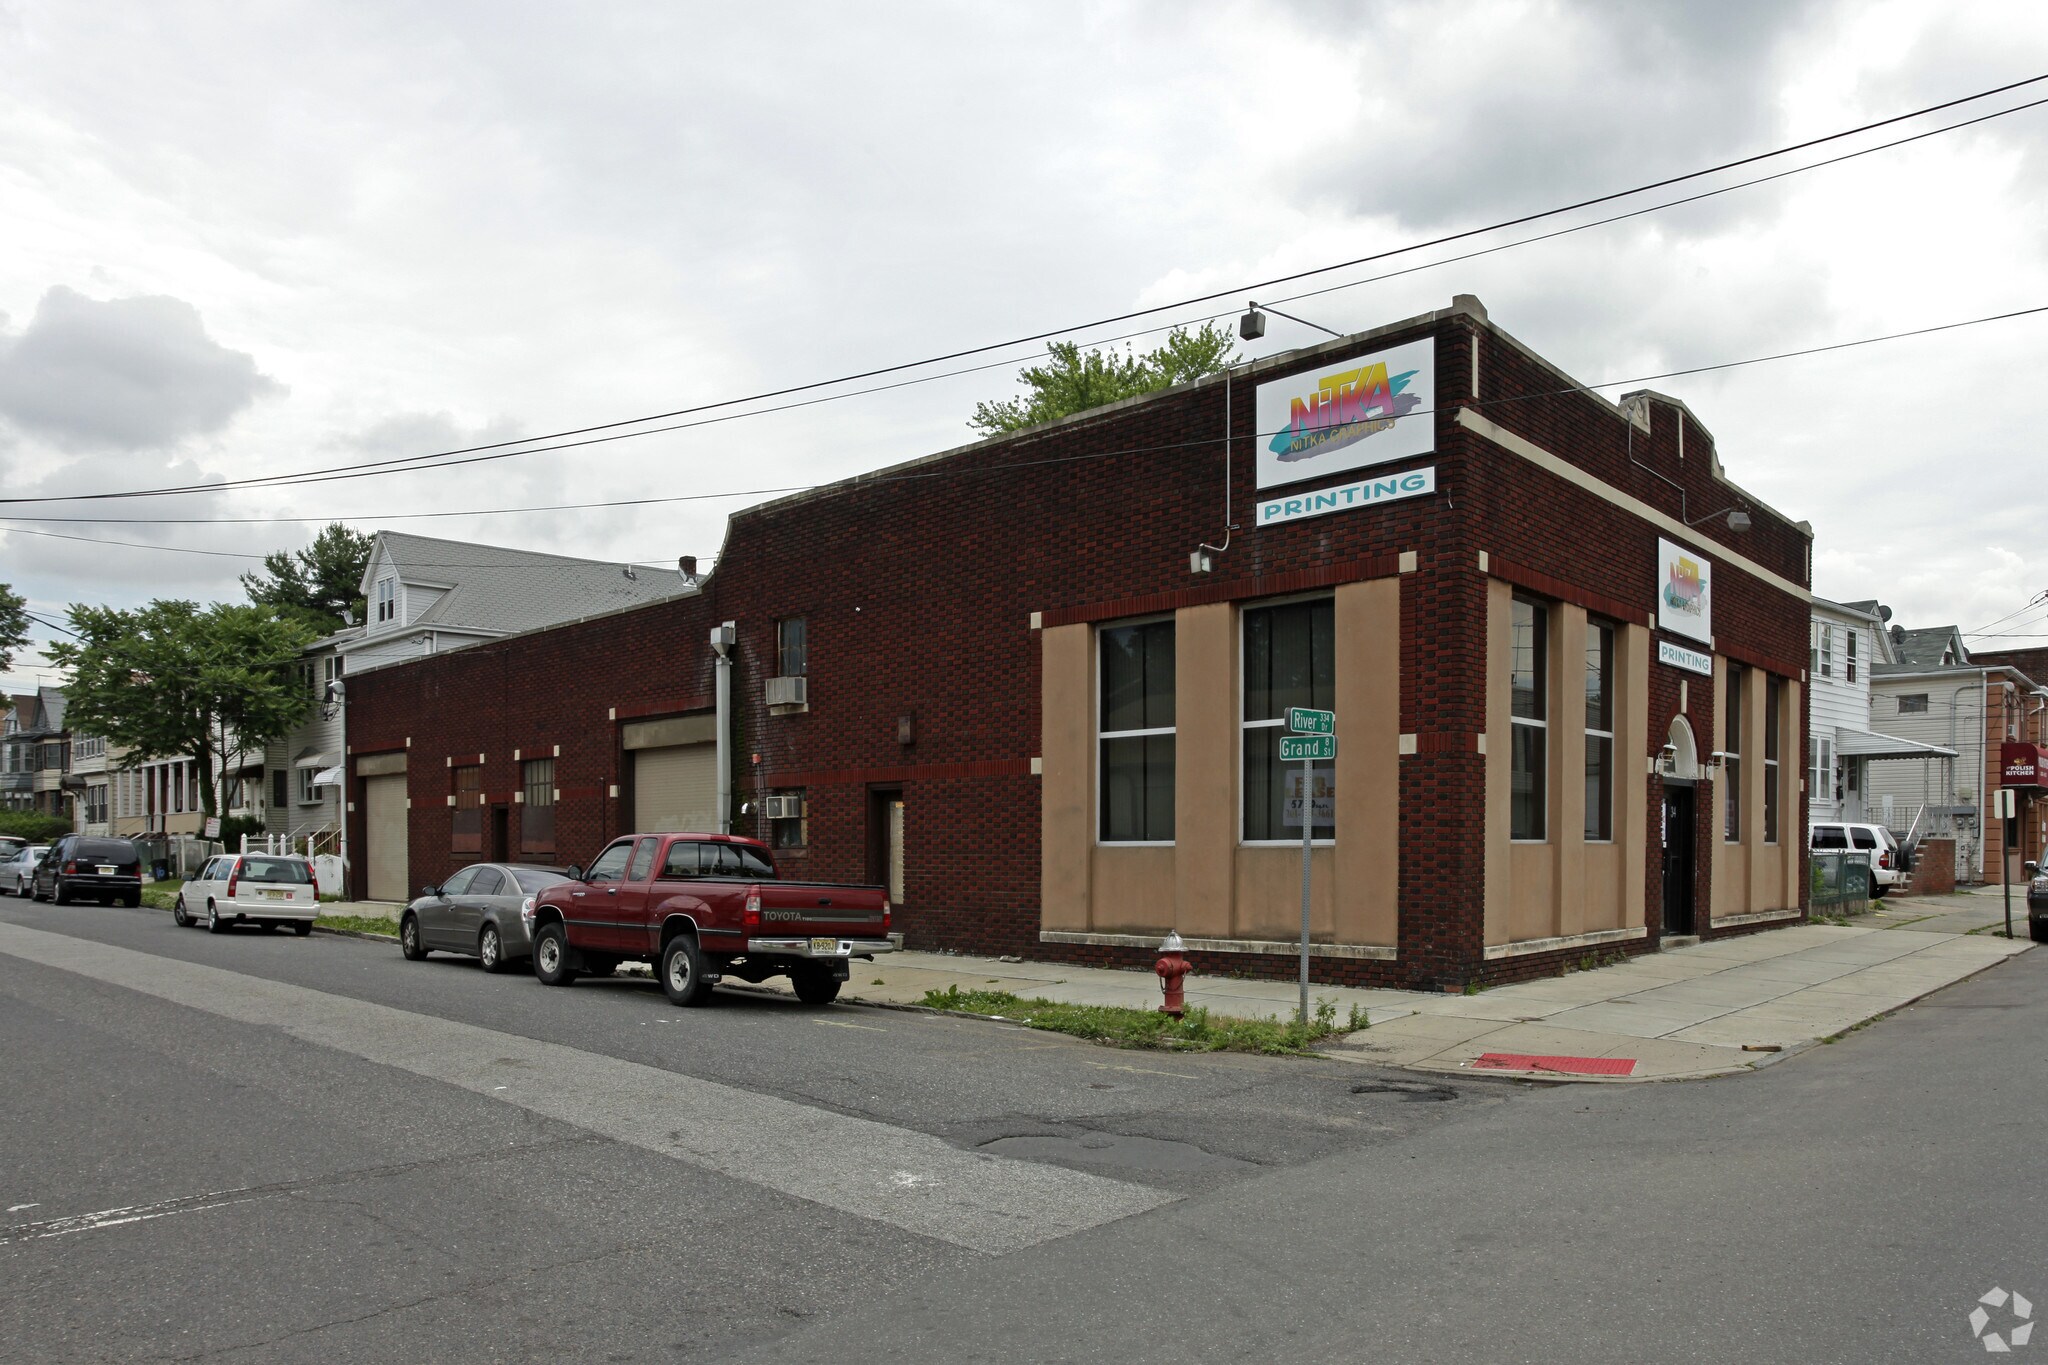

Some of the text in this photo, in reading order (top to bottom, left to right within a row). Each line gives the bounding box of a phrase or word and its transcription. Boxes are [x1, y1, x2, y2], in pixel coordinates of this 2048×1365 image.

[1290, 432, 1327, 452] NITKA
[1264, 474, 1426, 520] PRINTING
[1661, 646, 1709, 670] PRINTING
[1294, 712, 1317, 730] River
[1320, 713, 1329, 722] 334
[1321, 722, 1328, 731] Dr
[1281, 740, 1319, 756] Grand
[1324, 737, 1330, 746] 8
[1323, 747, 1331, 756] St
[763, 911, 801, 921] TOYOTA
